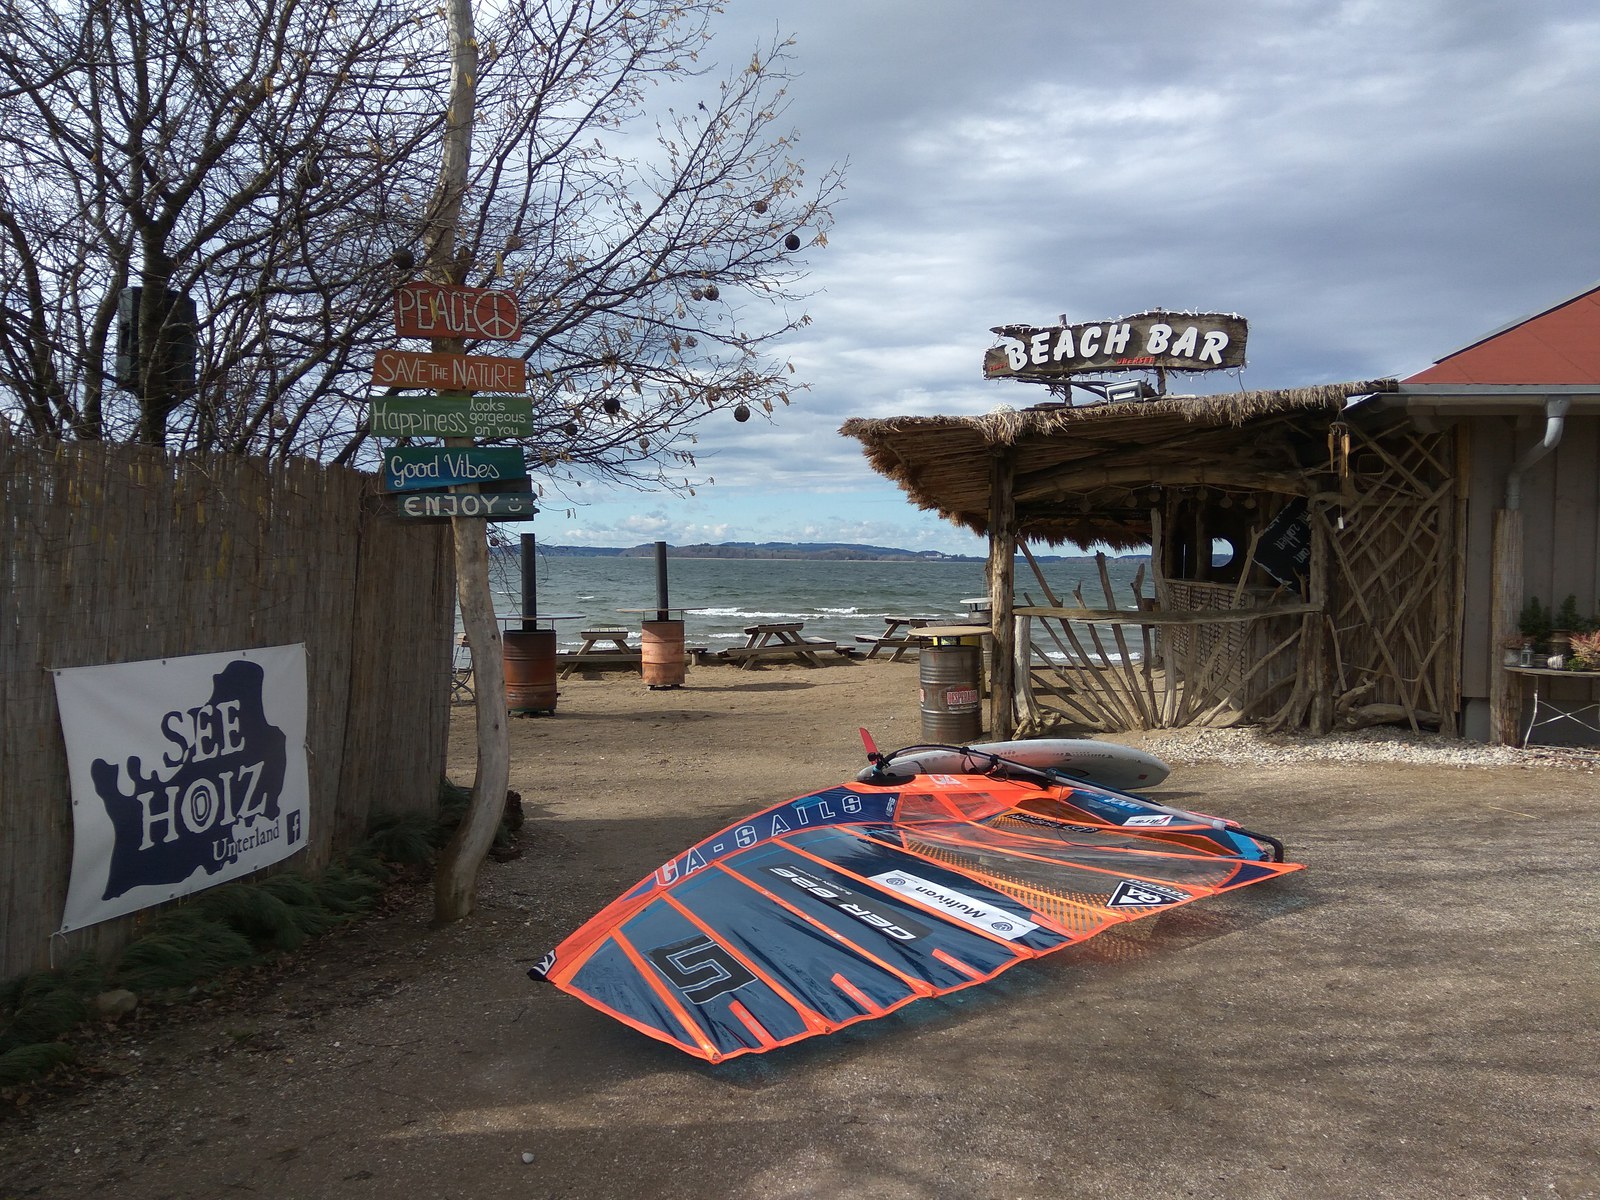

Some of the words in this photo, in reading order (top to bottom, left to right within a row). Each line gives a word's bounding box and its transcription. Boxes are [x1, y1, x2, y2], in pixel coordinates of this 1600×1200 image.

[399, 288, 476, 333] PEACE
[1004, 322, 1132, 372] BEACH
[1146, 323, 1230, 365] BAR
[377, 354, 428, 383] SAVE
[428, 363, 448, 381] THE
[452, 359, 519, 390] NATURE
[372, 401, 468, 435] Happiness
[468, 411, 527, 425] gorgeous
[469, 397, 506, 412] looks
[474, 425, 491, 437] on
[390, 454, 440, 488] Good
[443, 453, 500, 480] Vibes
[404, 494, 500, 516] ENJOY
[161, 699, 246, 769] SEE
[136, 760, 269, 852] HOIZ
[212, 819, 281, 861] Unterland
[914, 885, 988, 918] Multivan
[839, 902, 917, 941] GER
